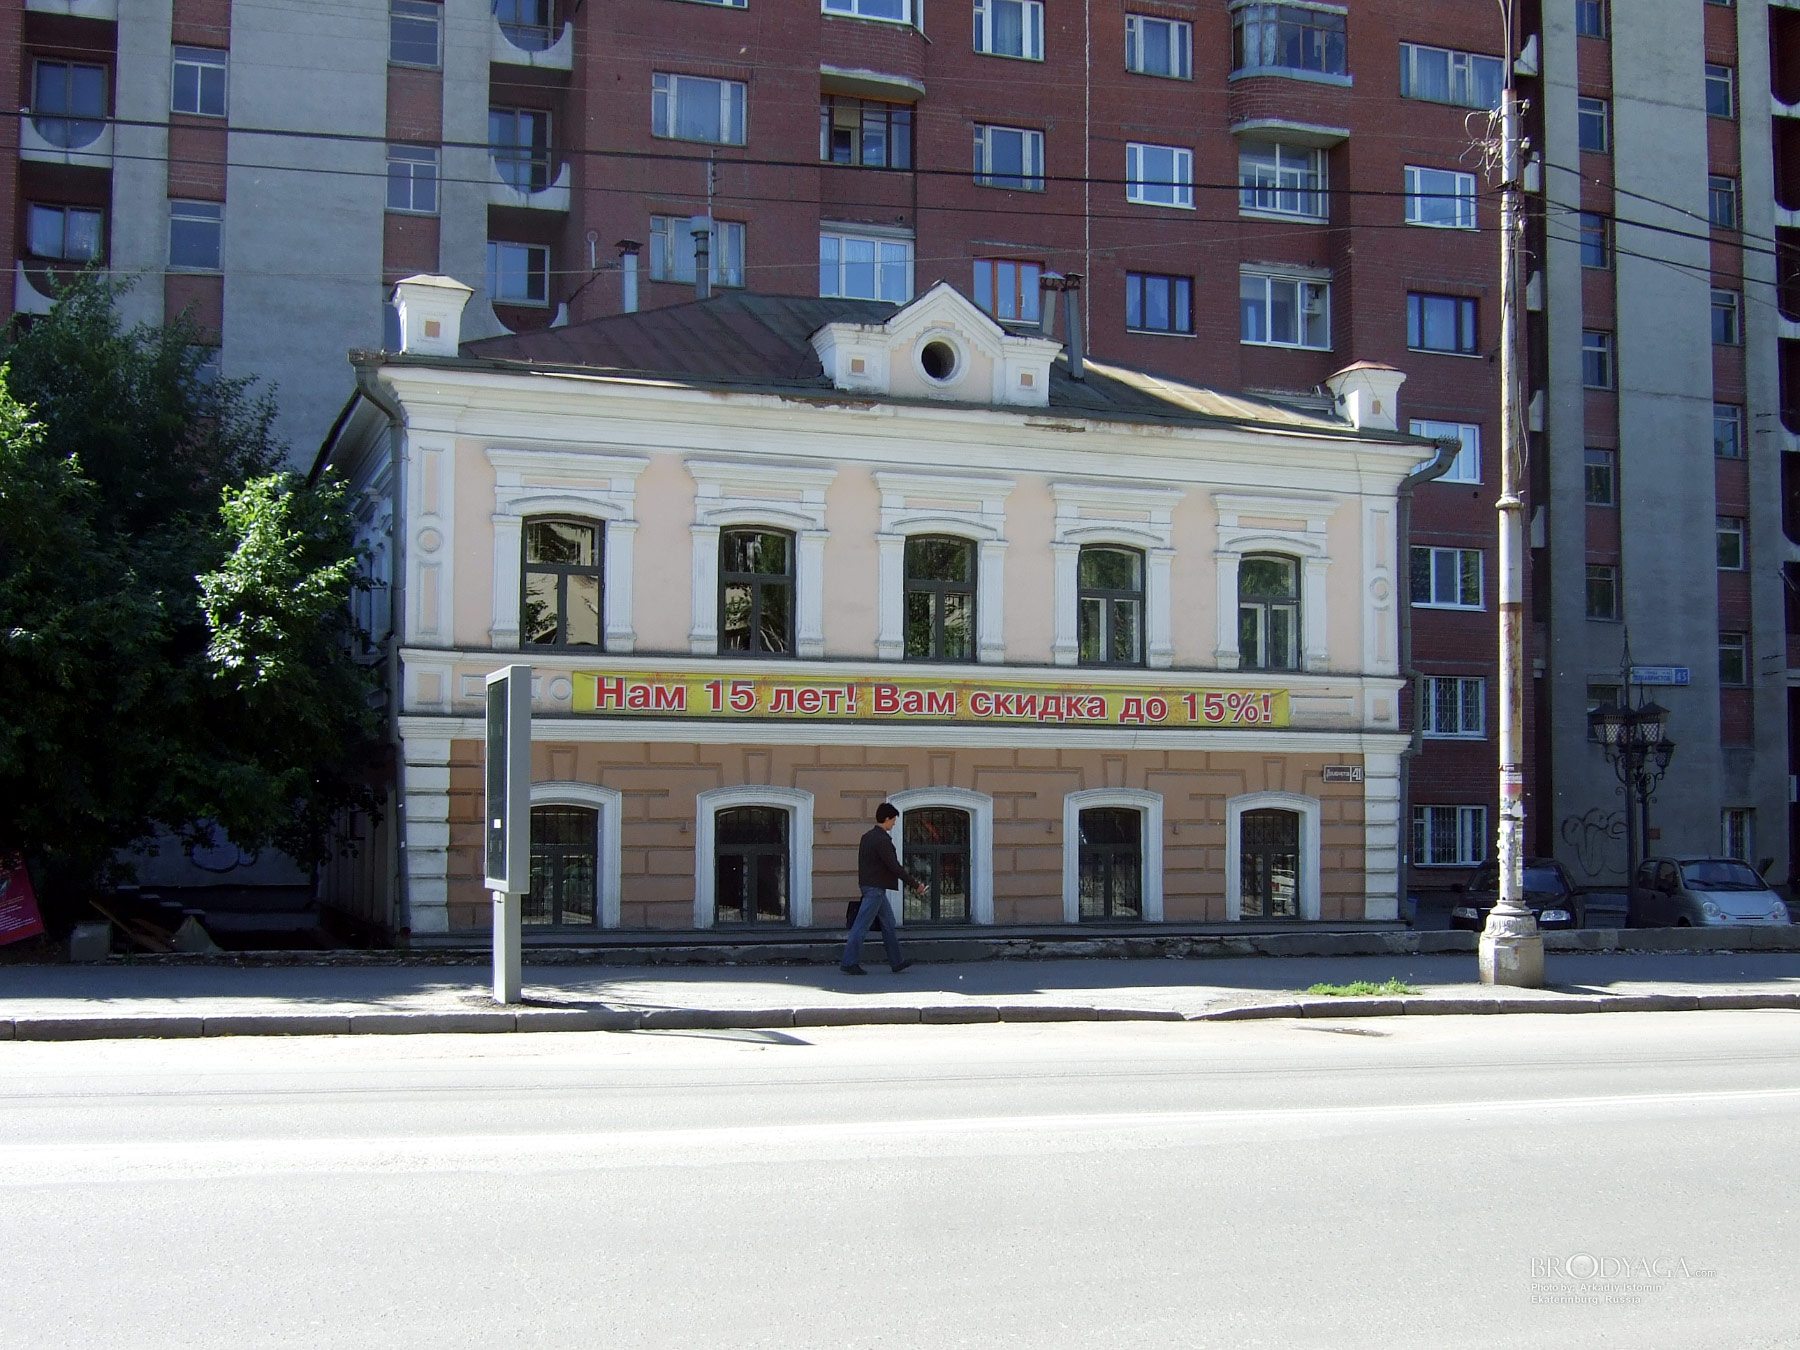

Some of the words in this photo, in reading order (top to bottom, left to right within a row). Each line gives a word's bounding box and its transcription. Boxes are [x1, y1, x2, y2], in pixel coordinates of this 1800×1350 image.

[1676, 671, 1688, 682] 45
[595, 676, 687, 710] Нам
[705, 679, 757, 712] 15
[769, 683, 857, 713] лет!
[873, 683, 956, 715] Вам
[970, 691, 1107, 723] скидка
[1118, 697, 1168, 725] до
[1183, 692, 1272, 723] 15%!
[1352, 768, 1361, 781] 41
